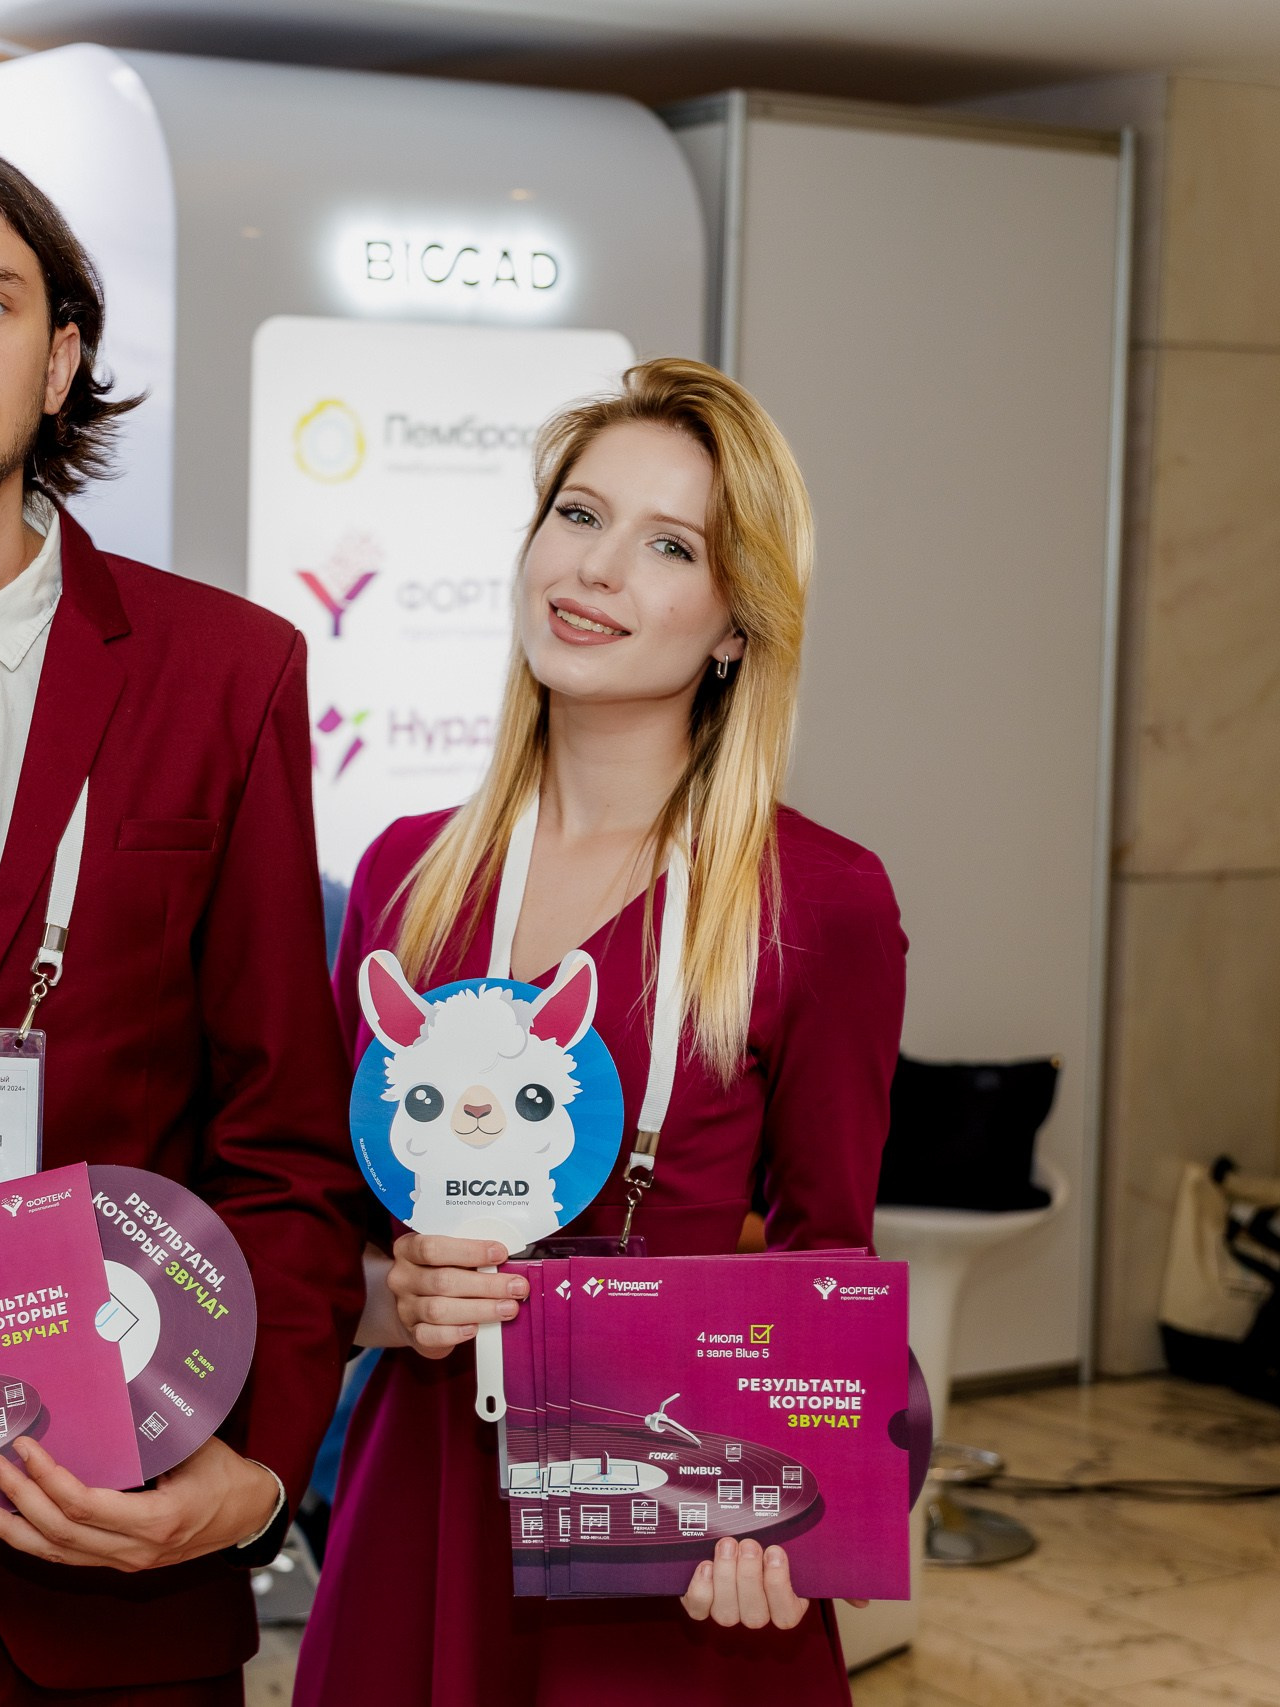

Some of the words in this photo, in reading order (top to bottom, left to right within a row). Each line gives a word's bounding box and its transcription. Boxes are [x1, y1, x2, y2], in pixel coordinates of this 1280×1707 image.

[446, 1180, 530, 1196] BIOCAD
[124, 1192, 225, 1293] РЕЗУЛЬТАТЫ,
[92, 1191, 169, 1266] КОТОРЫЕ
[165, 1261, 229, 1320] ЗВУЧАТ
[1, 1319, 70, 1347] ЗВУЧАТ
[697, 1332, 706, 1343] 4
[709, 1334, 743, 1344] июля
[697, 1350, 704, 1358] в
[706, 1350, 733, 1358] зале
[736, 1348, 760, 1358] Blue
[762, 1349, 769, 1358] 5
[184, 1357, 201, 1374] Blue
[199, 1371, 207, 1379] 5
[197, 1355, 215, 1372] зале
[738, 1378, 866, 1394] РЕЗУЛЬТАТЫ,
[160, 1383, 195, 1417] NIMBUS
[769, 1395, 861, 1410] КОТОРЫЕ
[787, 1414, 861, 1428] ЗВУЧАТ
[679, 1466, 722, 1475] NIMBUS
